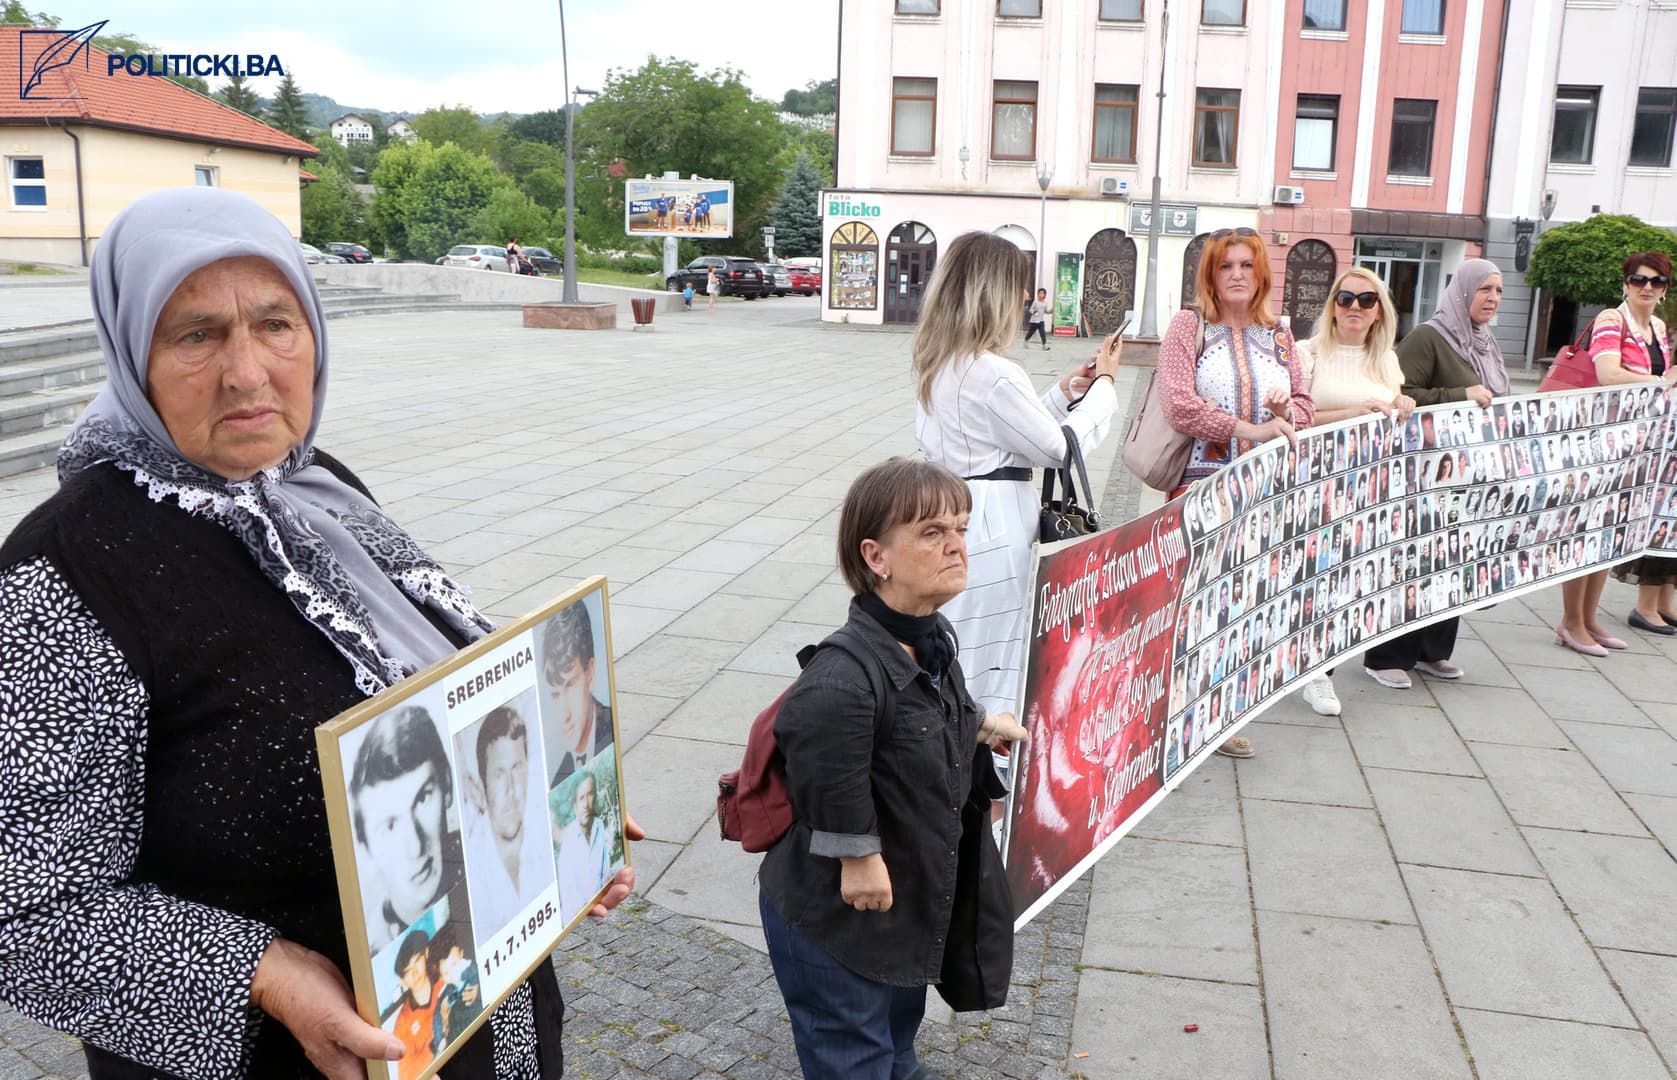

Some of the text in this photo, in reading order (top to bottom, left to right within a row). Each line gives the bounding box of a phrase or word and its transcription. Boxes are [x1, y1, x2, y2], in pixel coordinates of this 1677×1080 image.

[828, 200, 881, 217] Blicko
[1037, 516, 1187, 642] Fotografije žrtava nad kojim
[447, 647, 534, 710] SREBRENICA
[1087, 721, 1164, 830] u Srebrenici
[484, 901, 557, 976] 11.7.1995.
